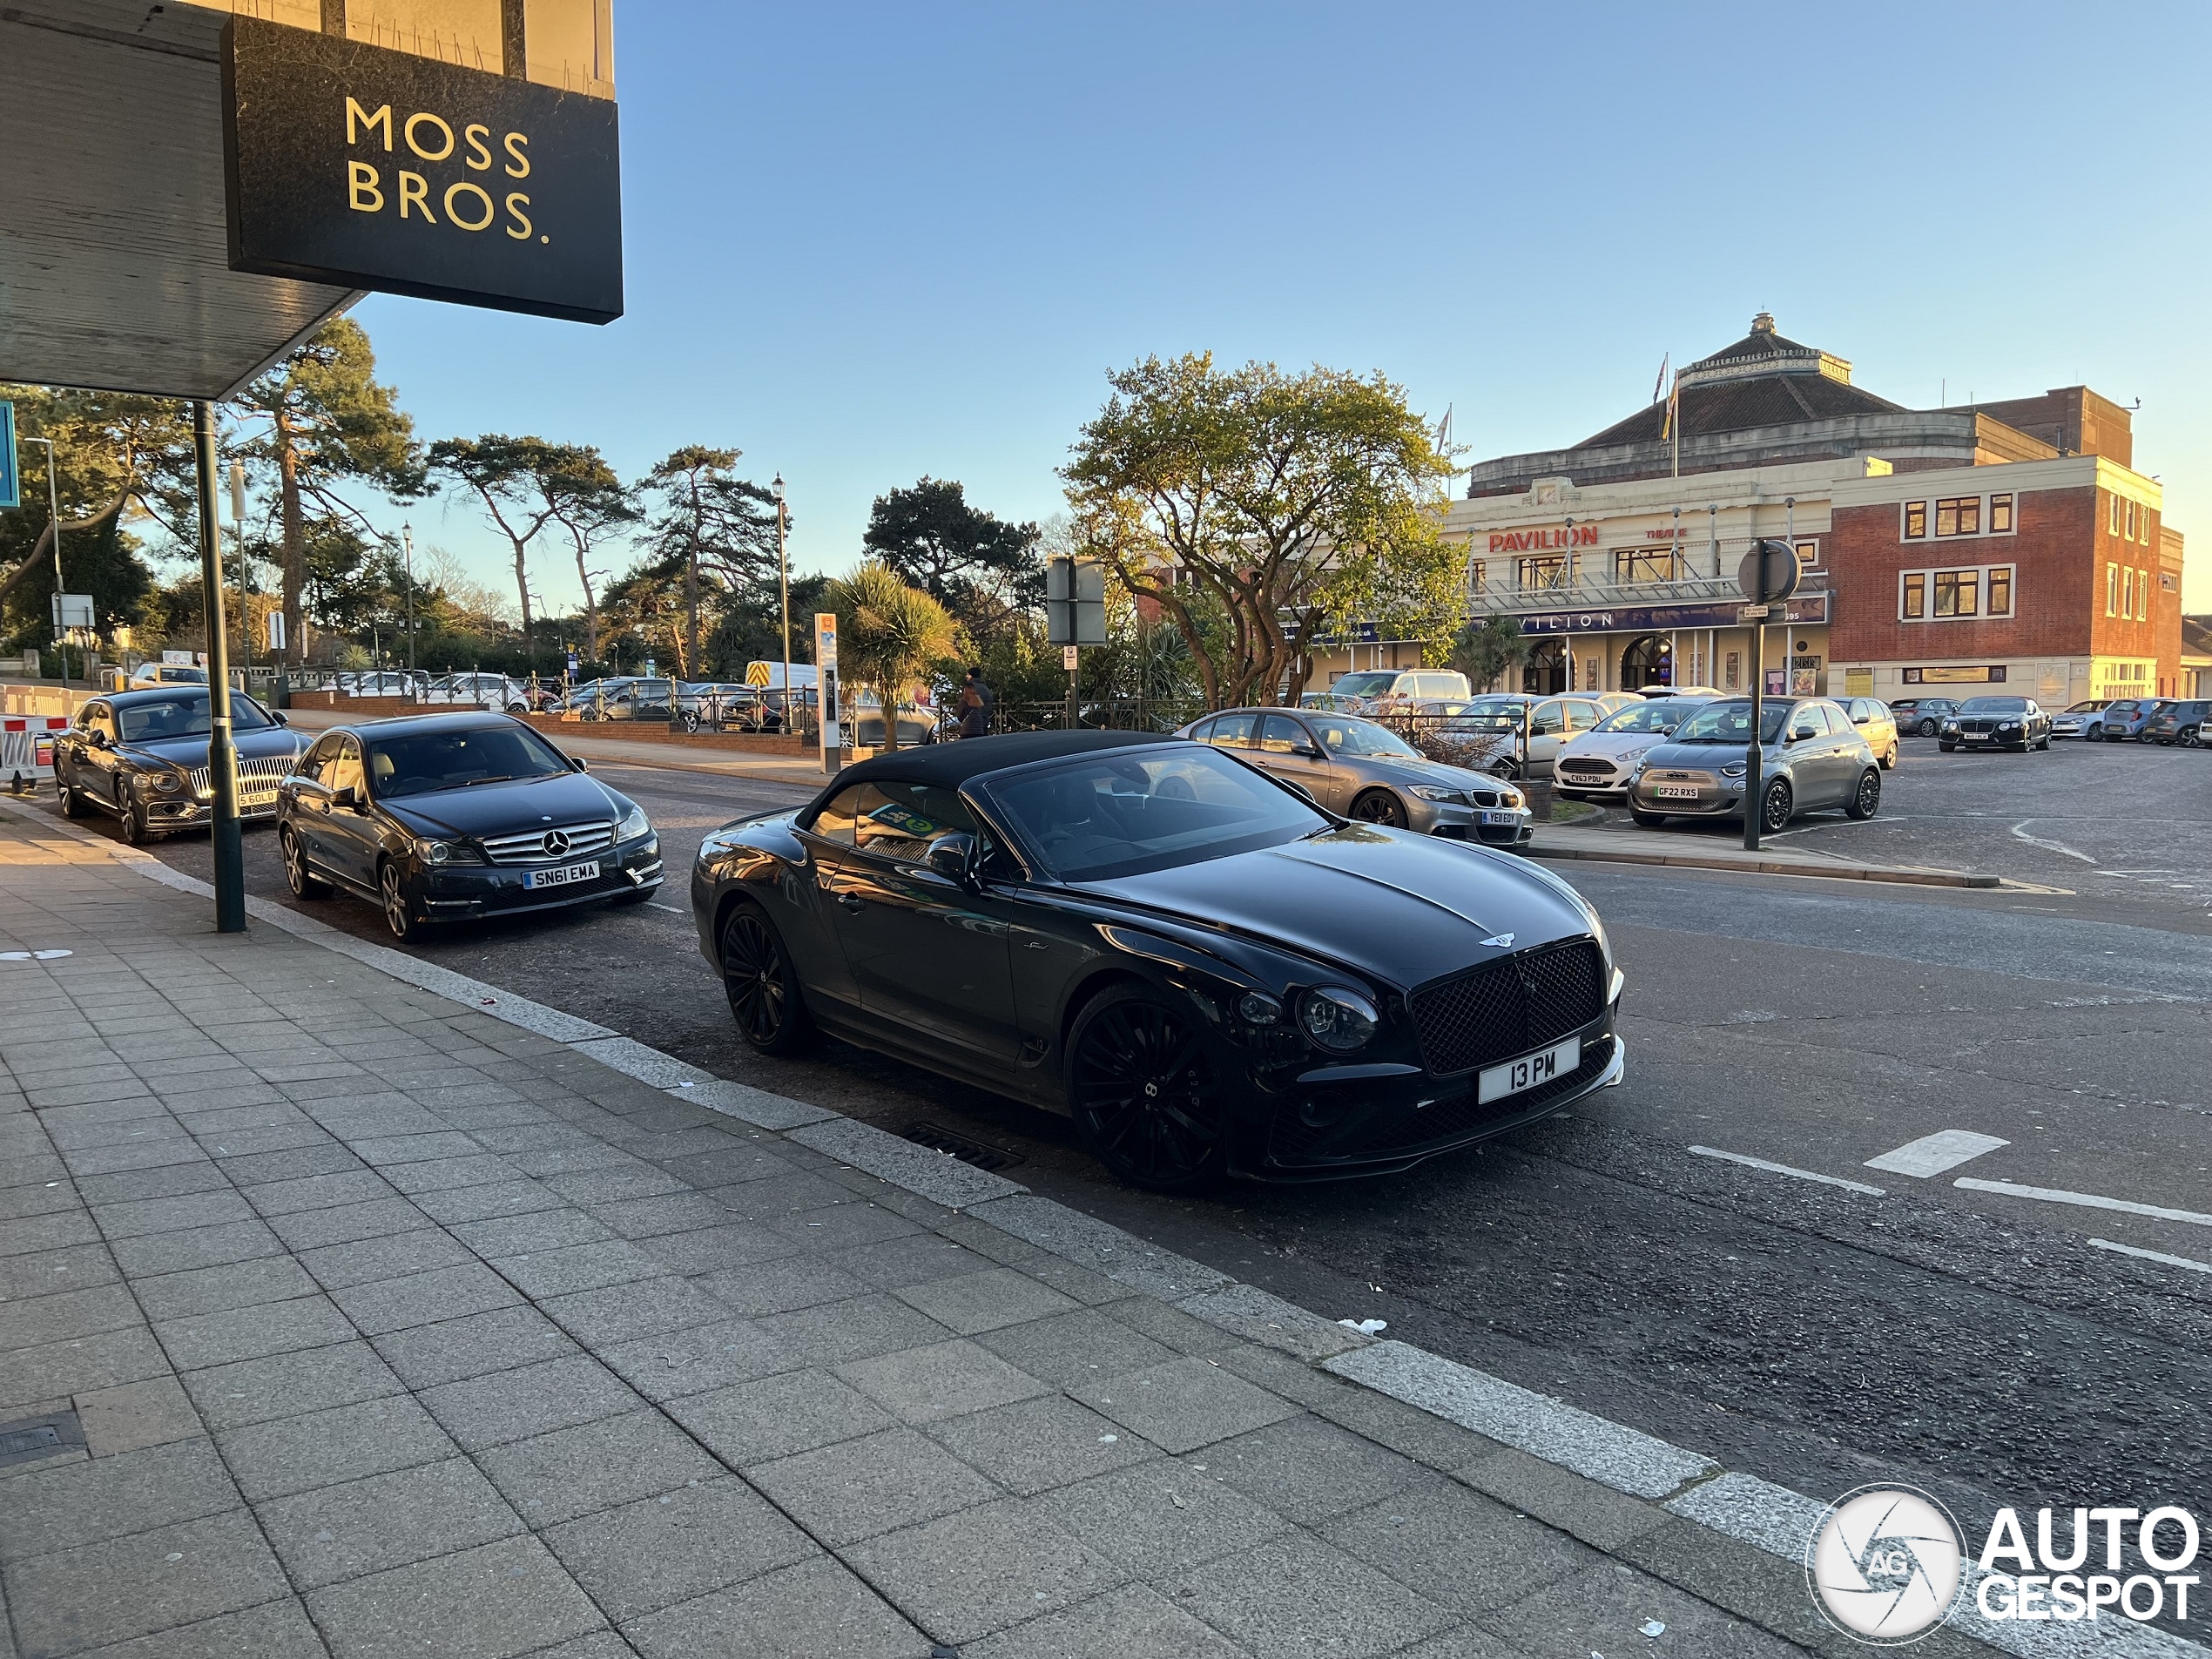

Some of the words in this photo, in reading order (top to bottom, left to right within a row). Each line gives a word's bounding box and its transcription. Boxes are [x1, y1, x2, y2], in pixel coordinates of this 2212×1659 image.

[346, 97, 530, 179] MOSS
[347, 160, 550, 244] BROS.
[1489, 526, 1598, 552] PAVILION
[1481, 613, 1612, 630] PVILION
[1681, 788, 1696, 797] RXS
[536, 869, 568, 885] SN61
[570, 864, 595, 880] EMA
[1511, 1062, 1527, 1090] 13
[1534, 1051, 1555, 1082] PM
